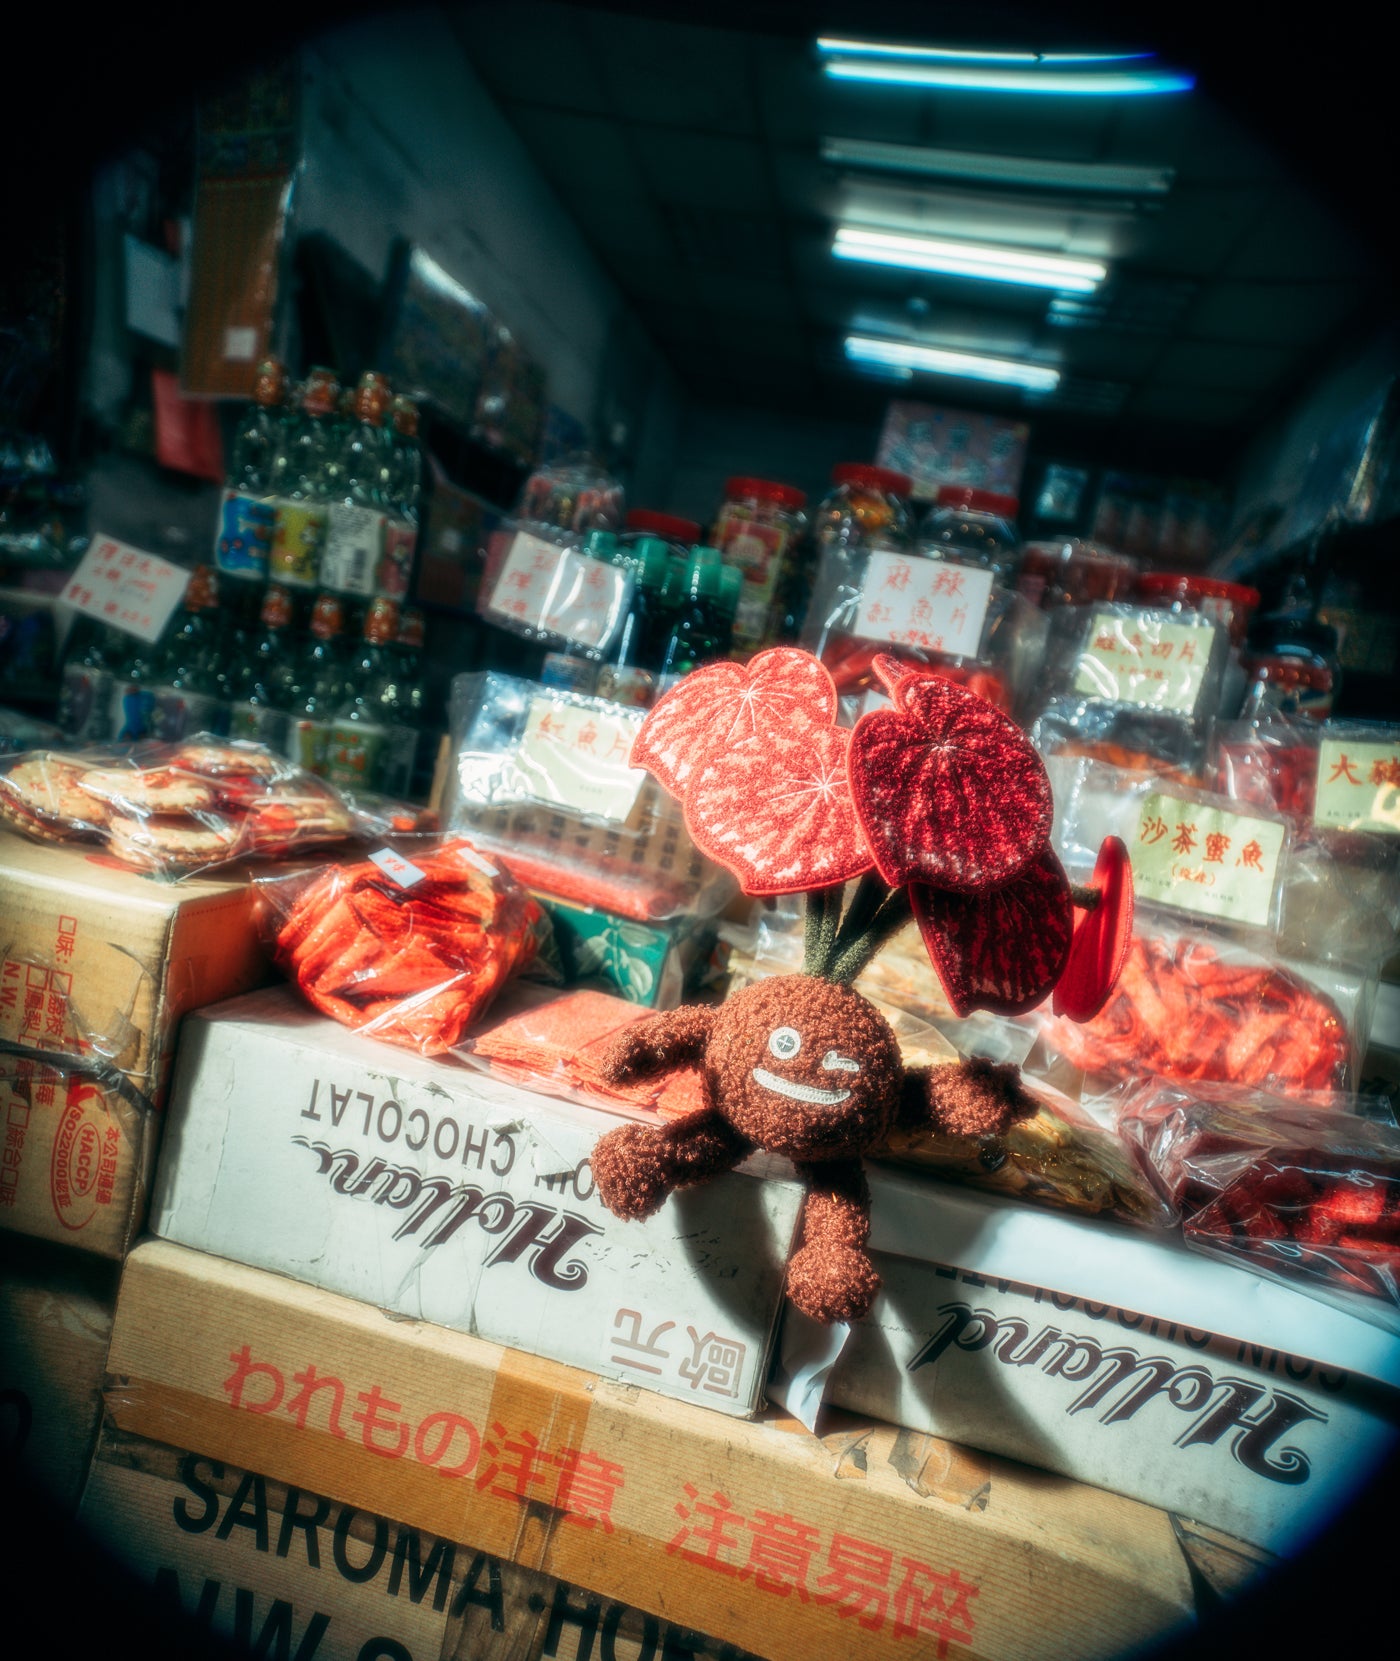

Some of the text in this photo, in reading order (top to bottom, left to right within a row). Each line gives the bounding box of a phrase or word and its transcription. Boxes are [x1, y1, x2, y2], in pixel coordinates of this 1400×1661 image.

[536, 713, 633, 762] 紅魚片
[1140, 816, 1264, 872] 沙茶蜜魚
[75, 1129, 95, 1191] HACCP
[301, 1079, 516, 1176] CHOCOLAT
[290, 1135, 605, 1291] Hollan
[610, 1308, 746, 1398] 歐元
[905, 1302, 1329, 1486] Holland
[223, 1345, 980, 1660] われもの注意 注意易碎
